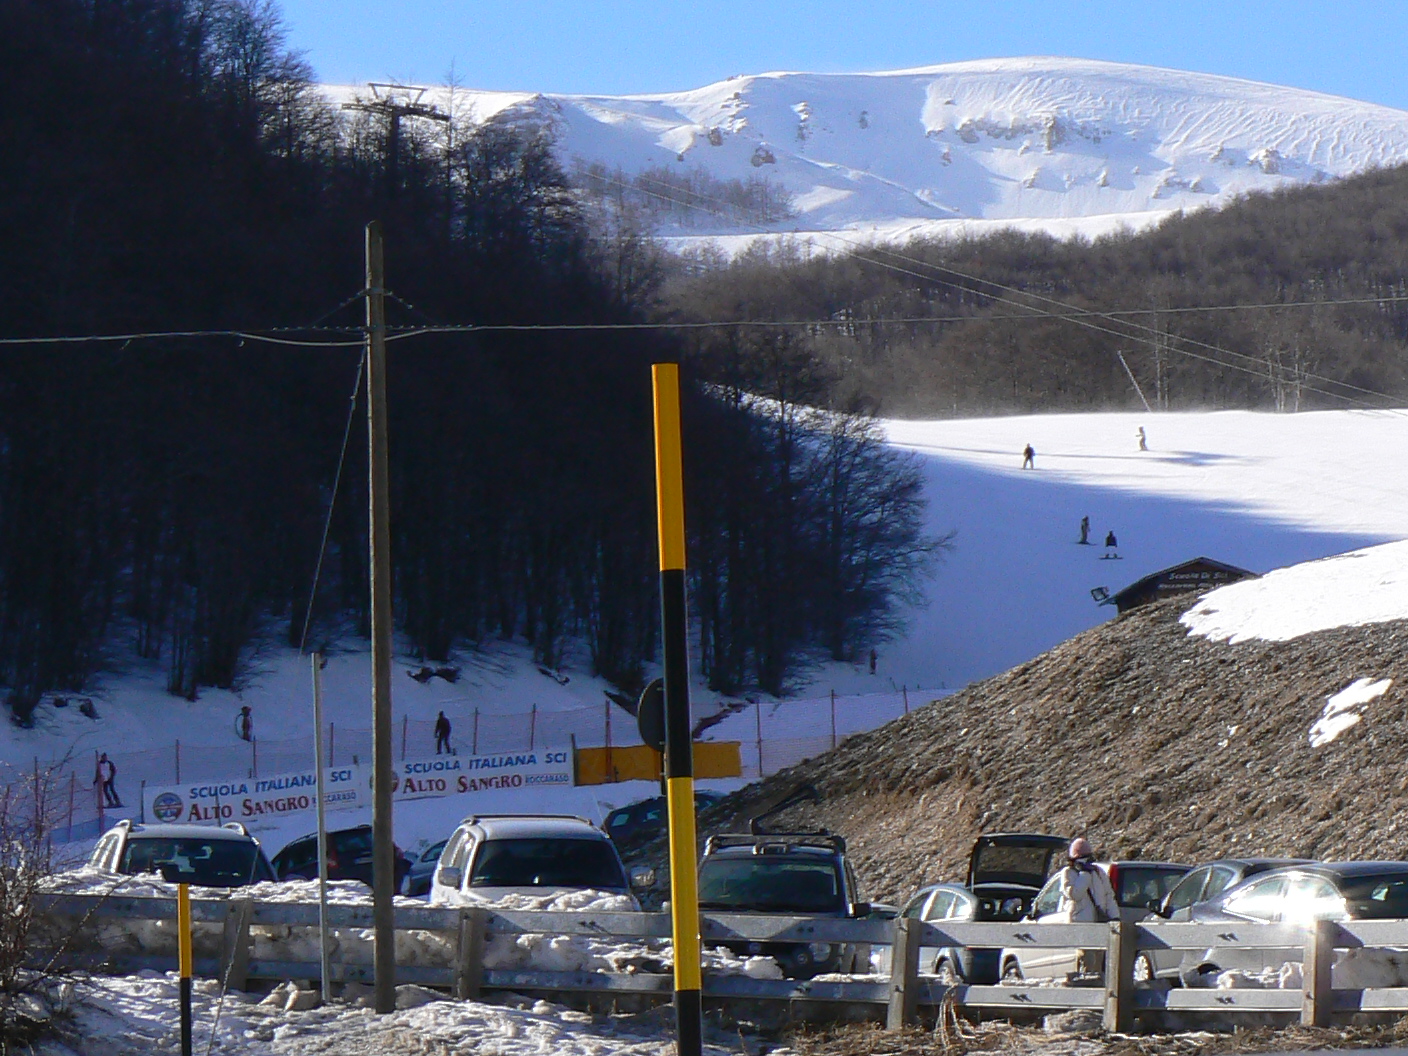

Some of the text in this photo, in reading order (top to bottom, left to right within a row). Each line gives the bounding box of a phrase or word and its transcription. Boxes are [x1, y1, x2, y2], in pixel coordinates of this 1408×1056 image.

[404, 752, 567, 774] SCUOLA ITALIANA SCI
[189, 783, 249, 800] SCUOLA
[330, 770, 352, 782] SCI
[403, 777, 446, 794] ALTO
[457, 774, 523, 793] SANGRO
[187, 804, 232, 822] ALTO
[242, 796, 309, 817] SANGRO
